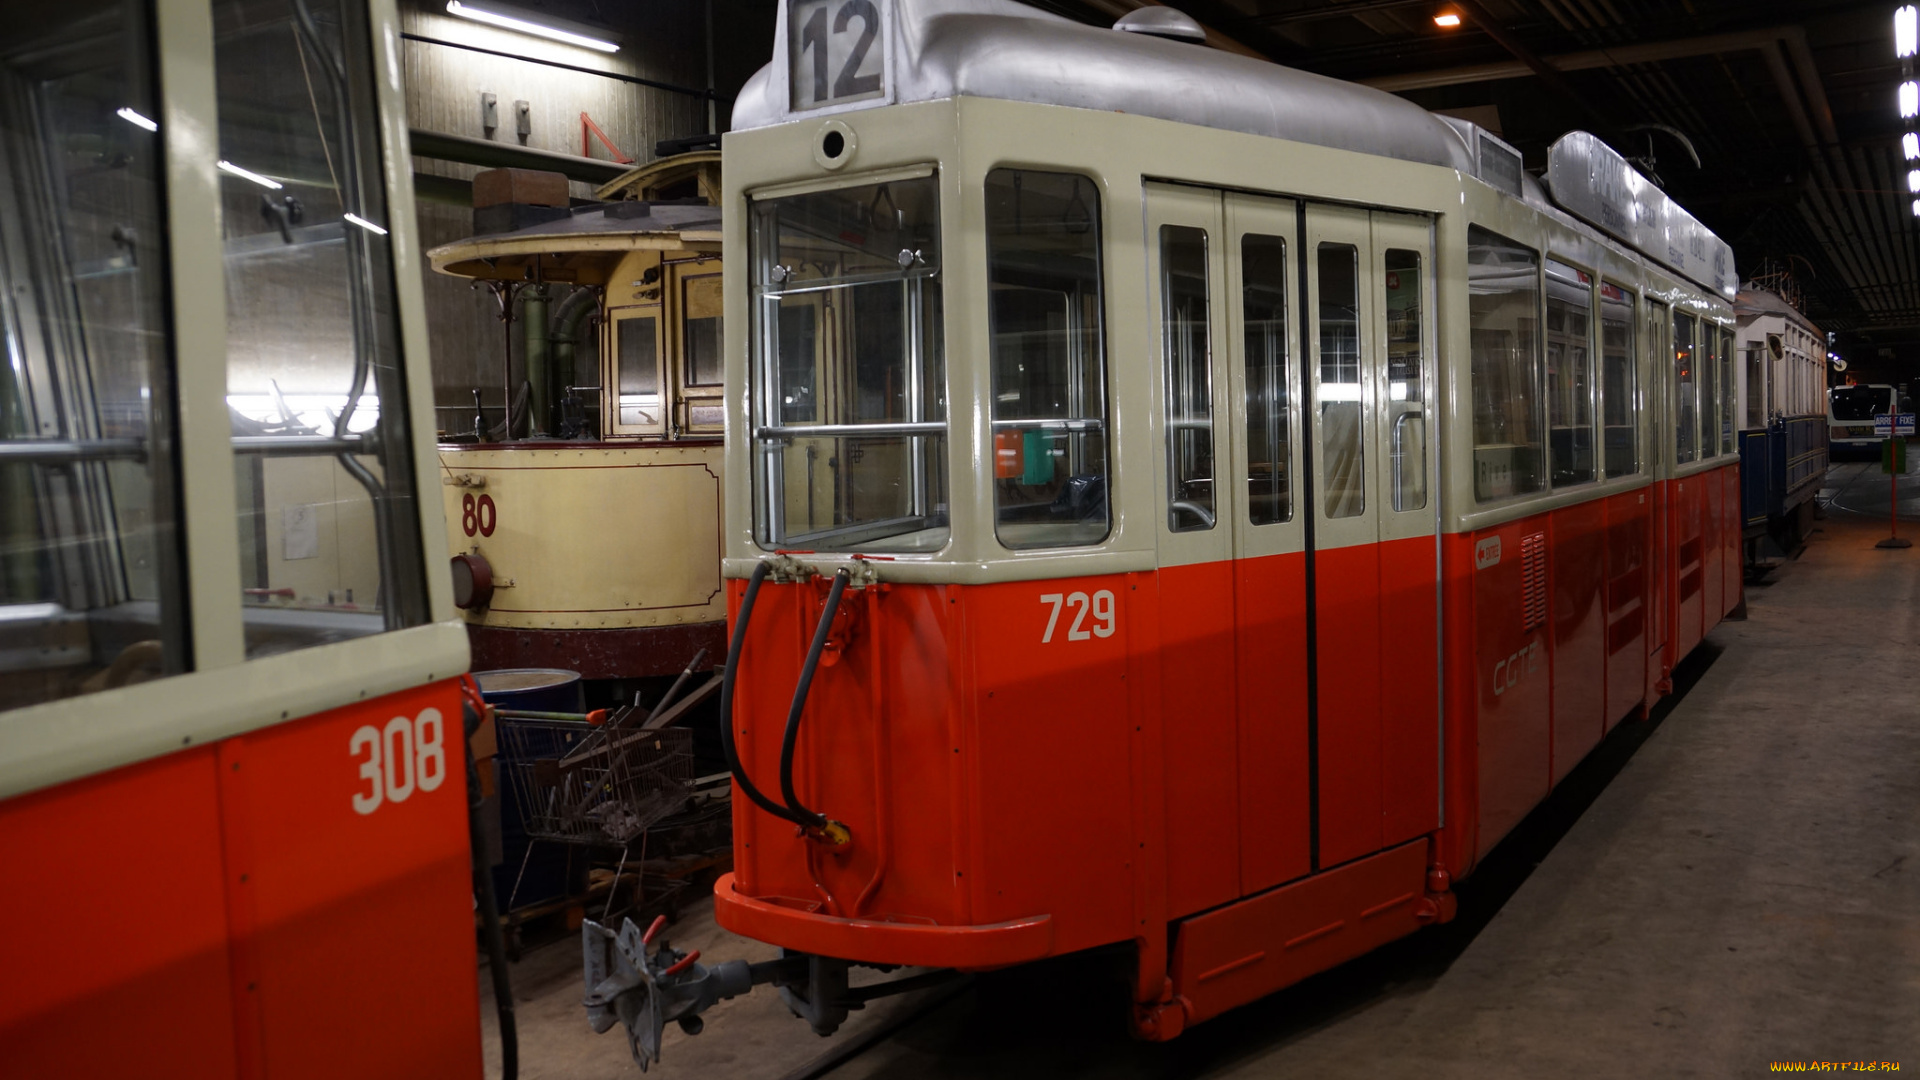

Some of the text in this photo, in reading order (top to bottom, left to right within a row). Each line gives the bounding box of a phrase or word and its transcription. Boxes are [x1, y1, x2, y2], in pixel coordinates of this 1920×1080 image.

[803, 0, 880, 102] 12
[1899, 416, 1914, 424] FIXE
[1481, 460, 1507, 484] Rive
[462, 493, 496, 538] 80
[1040, 590, 1116, 643] 729
[1493, 641, 1538, 696] CGTE
[349, 707, 445, 815] 308
